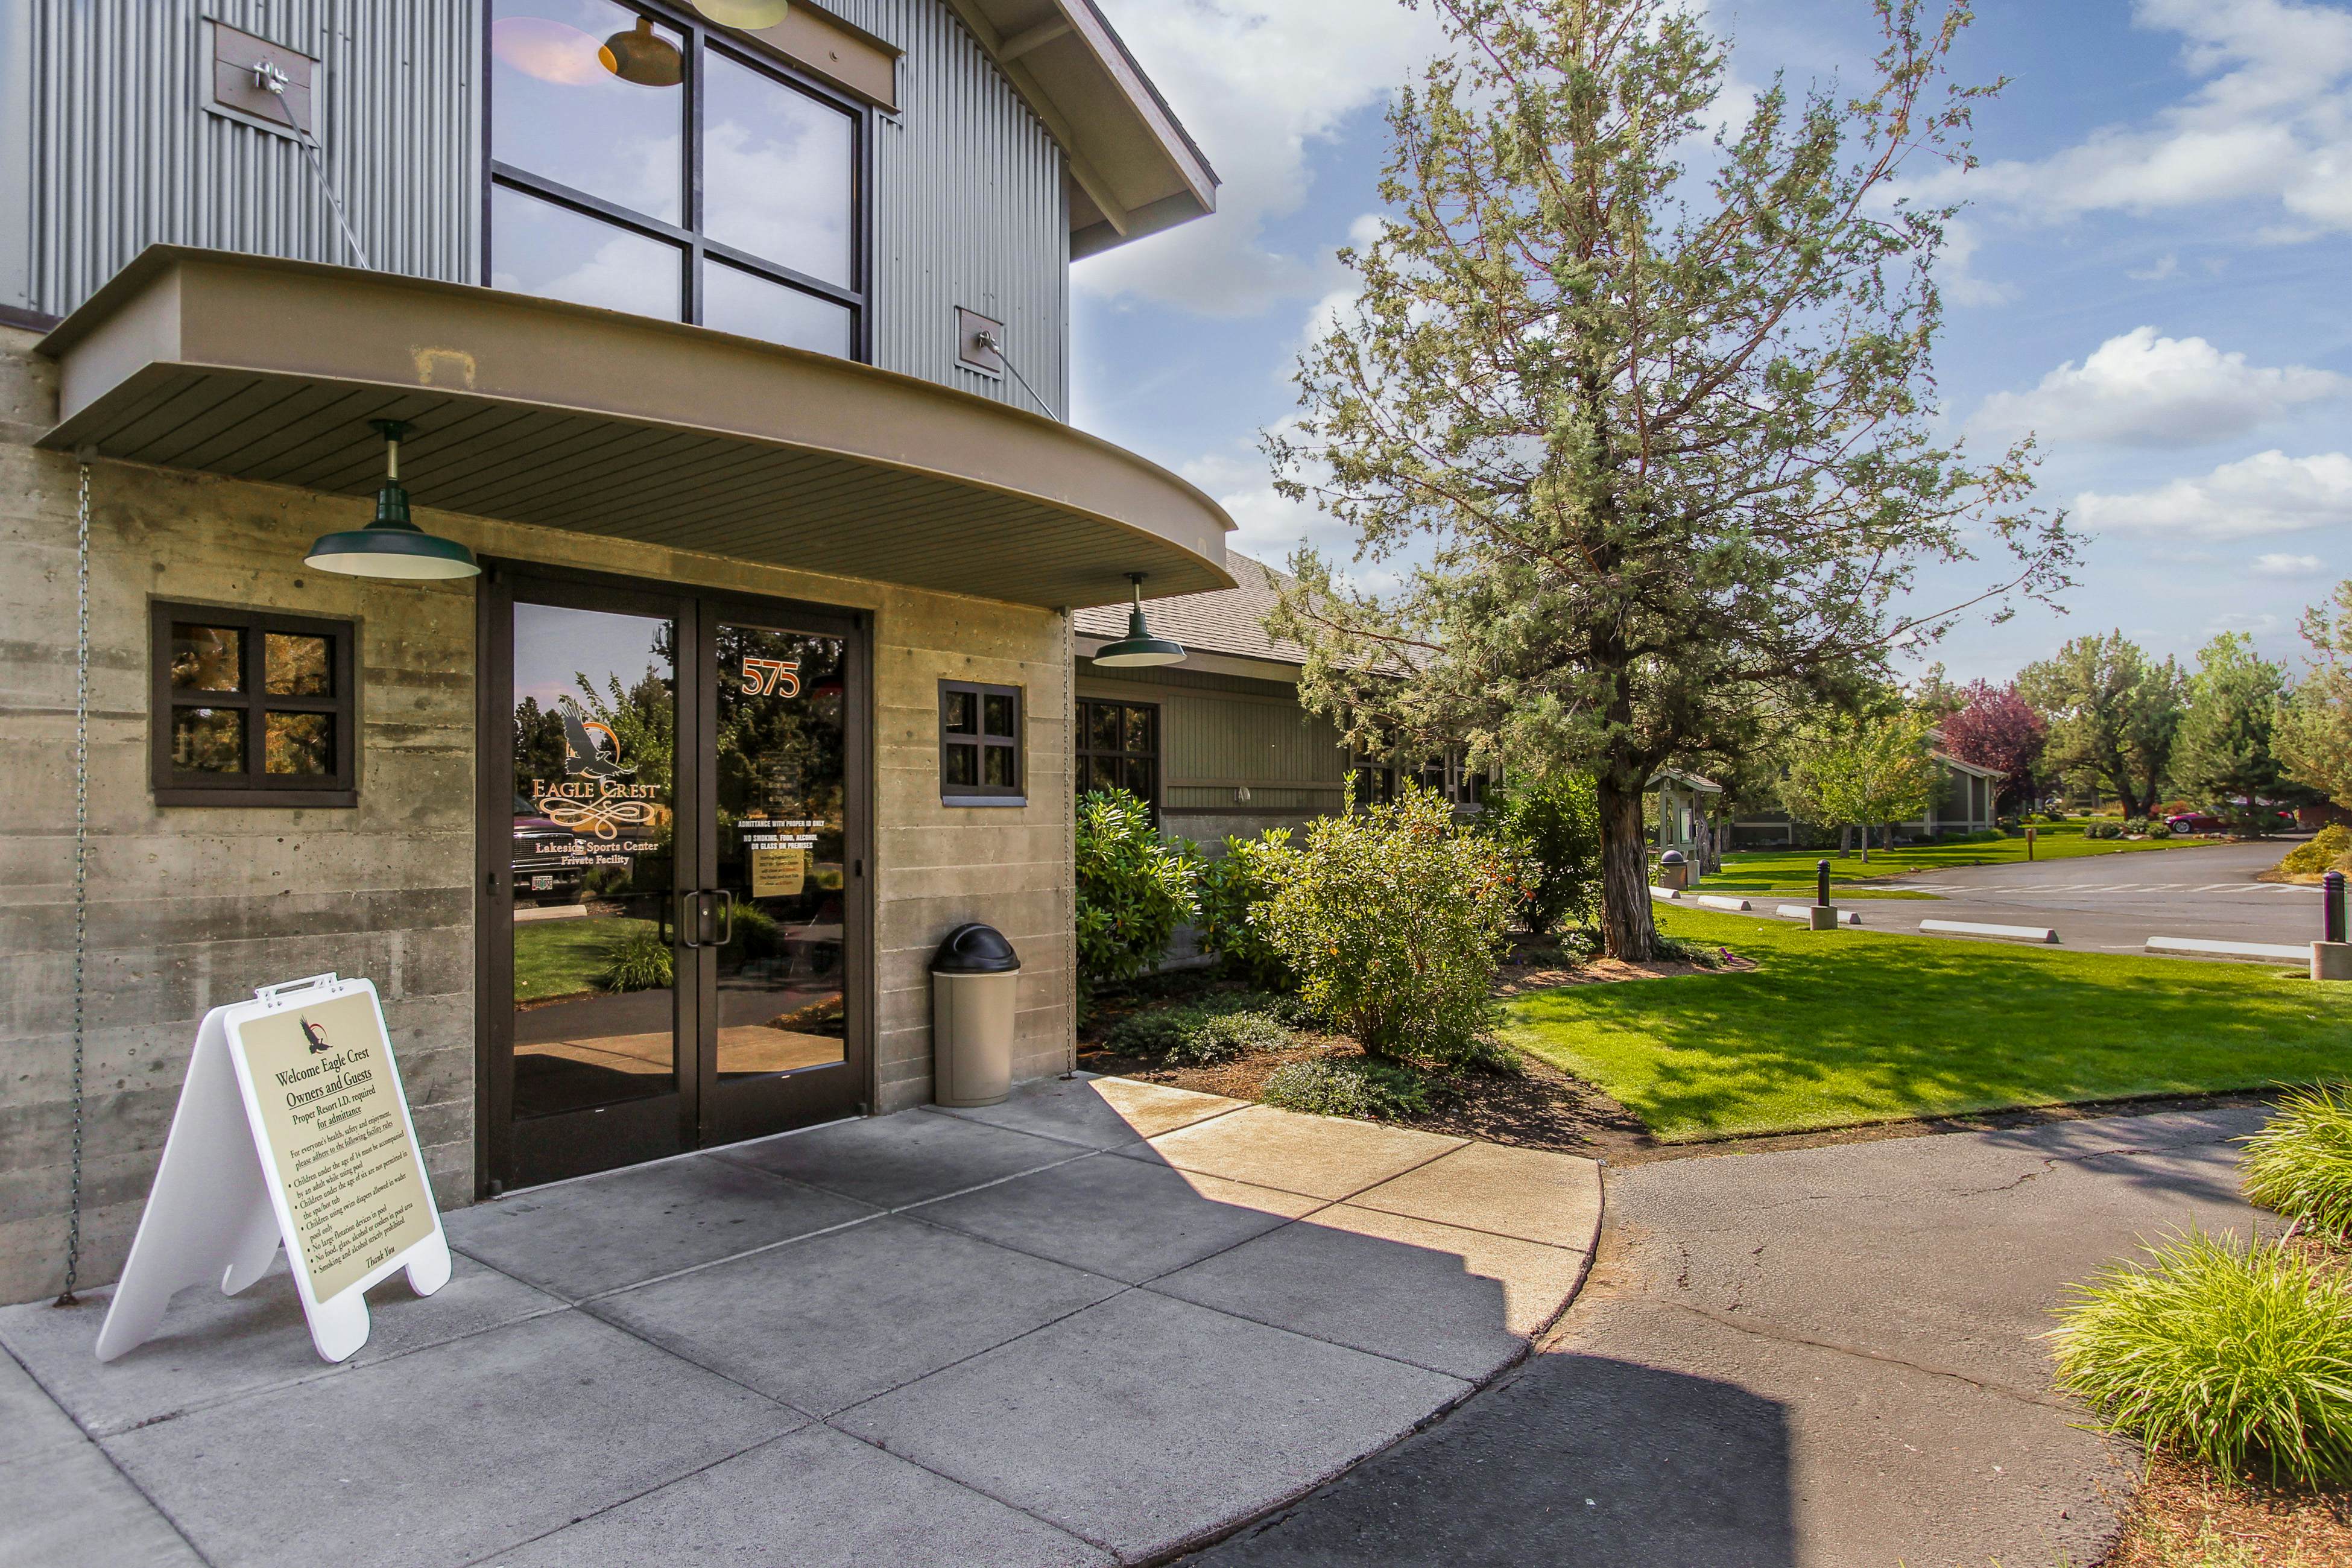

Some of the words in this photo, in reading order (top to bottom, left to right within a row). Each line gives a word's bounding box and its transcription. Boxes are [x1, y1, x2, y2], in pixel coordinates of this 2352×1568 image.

[742, 657, 800, 698] 575
[536, 842, 584, 853] Lakeside
[587, 842, 621, 853] Sports
[623, 841, 659, 851] Center
[561, 856, 593, 865] Private
[596, 855, 630, 865] Facility
[275, 1069, 320, 1087] Welcome
[321, 1054, 346, 1072] Eagle
[347, 1048, 370, 1063] Crest
[286, 1086, 324, 1107] Owners
[326, 1075, 343, 1093] and
[344, 1069, 372, 1086] Guests
[292, 1111, 315, 1125] Proper
[316, 1101, 338, 1115] Resort
[338, 1095, 351, 1107] I.D.
[352, 1085, 376, 1102] required
[302, 1137, 327, 1154] everyone's
[327, 1130, 344, 1143] health,
[344, 1125, 358, 1136] safety
[359, 1119, 368, 1128] and
[368, 1110, 391, 1124] enjoyment,
[317, 1119, 326, 1129] for
[329, 1106, 362, 1125] admittance
[294, 1172, 317, 1187] Children
[317, 1166, 332, 1177] under
[341, 1158, 350, 1167] age
[362, 1148, 372, 1156] must
[379, 1130, 405, 1148] accompanied
[296, 1158, 311, 1171] please
[312, 1150, 329, 1162] adhere
[336, 1142, 344, 1151] the
[344, 1133, 367, 1147] following
[367, 1126, 382, 1137] facility
[382, 1121, 393, 1130] rules
[300, 1193, 323, 1209] Children
[324, 1187, 338, 1198] under
[347, 1178, 356, 1187] age
[356, 1173, 361, 1181] of
[384, 1152, 403, 1169] permitted
[312, 1180, 326, 1191] adult
[326, 1172, 339, 1184] while
[340, 1167, 353, 1178] using
[353, 1162, 364, 1174] pool
[303, 1212, 312, 1220] the
[312, 1201, 331, 1216] spa/hot
[332, 1196, 341, 1205] tub
[306, 1213, 329, 1230] Children
[329, 1207, 344, 1218] using
[343, 1201, 356, 1211] swim
[356, 1192, 373, 1204] diapers
[373, 1180, 389, 1196] allowed
[394, 1172, 407, 1182] wader
[310, 1230, 321, 1244] pool
[322, 1225, 333, 1234] only
[312, 1241, 321, 1251] No
[322, 1236, 335, 1247] large
[335, 1224, 355, 1239] flotation
[356, 1216, 371, 1227] devices
[378, 1204, 387, 1216] pool
[315, 1253, 324, 1262] No
[324, 1245, 338, 1258] food,
[339, 1241, 352, 1251] glass,
[352, 1227, 368, 1243] alcohol
[375, 1216, 390, 1228] coolers
[394, 1205, 404, 1217] pool
[404, 1203, 413, 1211] area
[318, 1256, 342, 1273] Smoking
[342, 1248, 351, 1260] and
[352, 1239, 368, 1254] alcohol
[368, 1230, 384, 1244] strictly
[384, 1216, 405, 1236] prohibited
[365, 1250, 384, 1268] Thank
[383, 1246, 395, 1257] You
